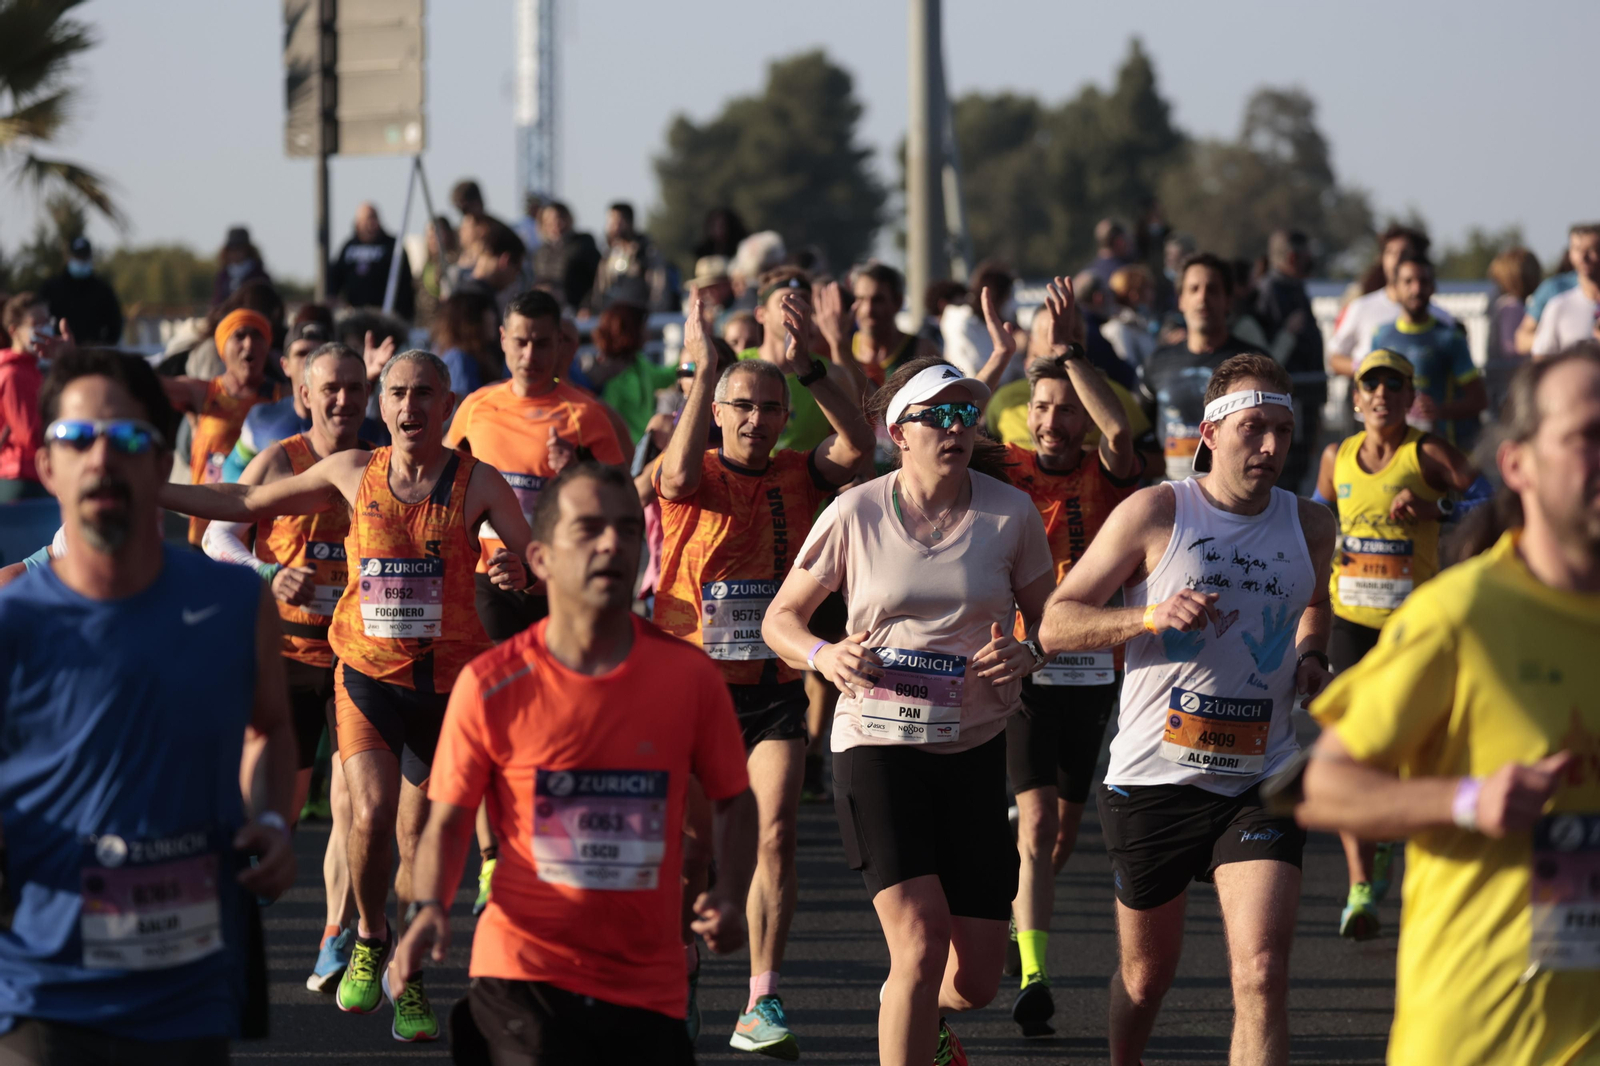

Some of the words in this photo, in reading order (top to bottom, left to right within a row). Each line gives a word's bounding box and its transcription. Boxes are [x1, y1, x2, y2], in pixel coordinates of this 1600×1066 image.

[1206, 395, 1253, 420] SCOTT
[1362, 541, 1405, 553] ZURICH
[384, 562, 433, 574] ZURICH
[731, 584, 776, 595] ZURICH
[1241, 580, 1261, 591] en
[385, 587, 413, 600] 6952
[375, 607, 424, 617] FOGONERO
[732, 609, 761, 622] 9575
[733, 629, 760, 640] OLIAS
[897, 654, 953, 672] ZURICH
[895, 683, 928, 699] 6909
[899, 706, 921, 719] PAN
[1203, 701, 1262, 717] ZURICH
[1199, 731, 1235, 748] 4909
[1188, 752, 1239, 768] ALBADRI
[578, 774, 655, 793] ZURICH
[581, 844, 620, 860] ESCU
